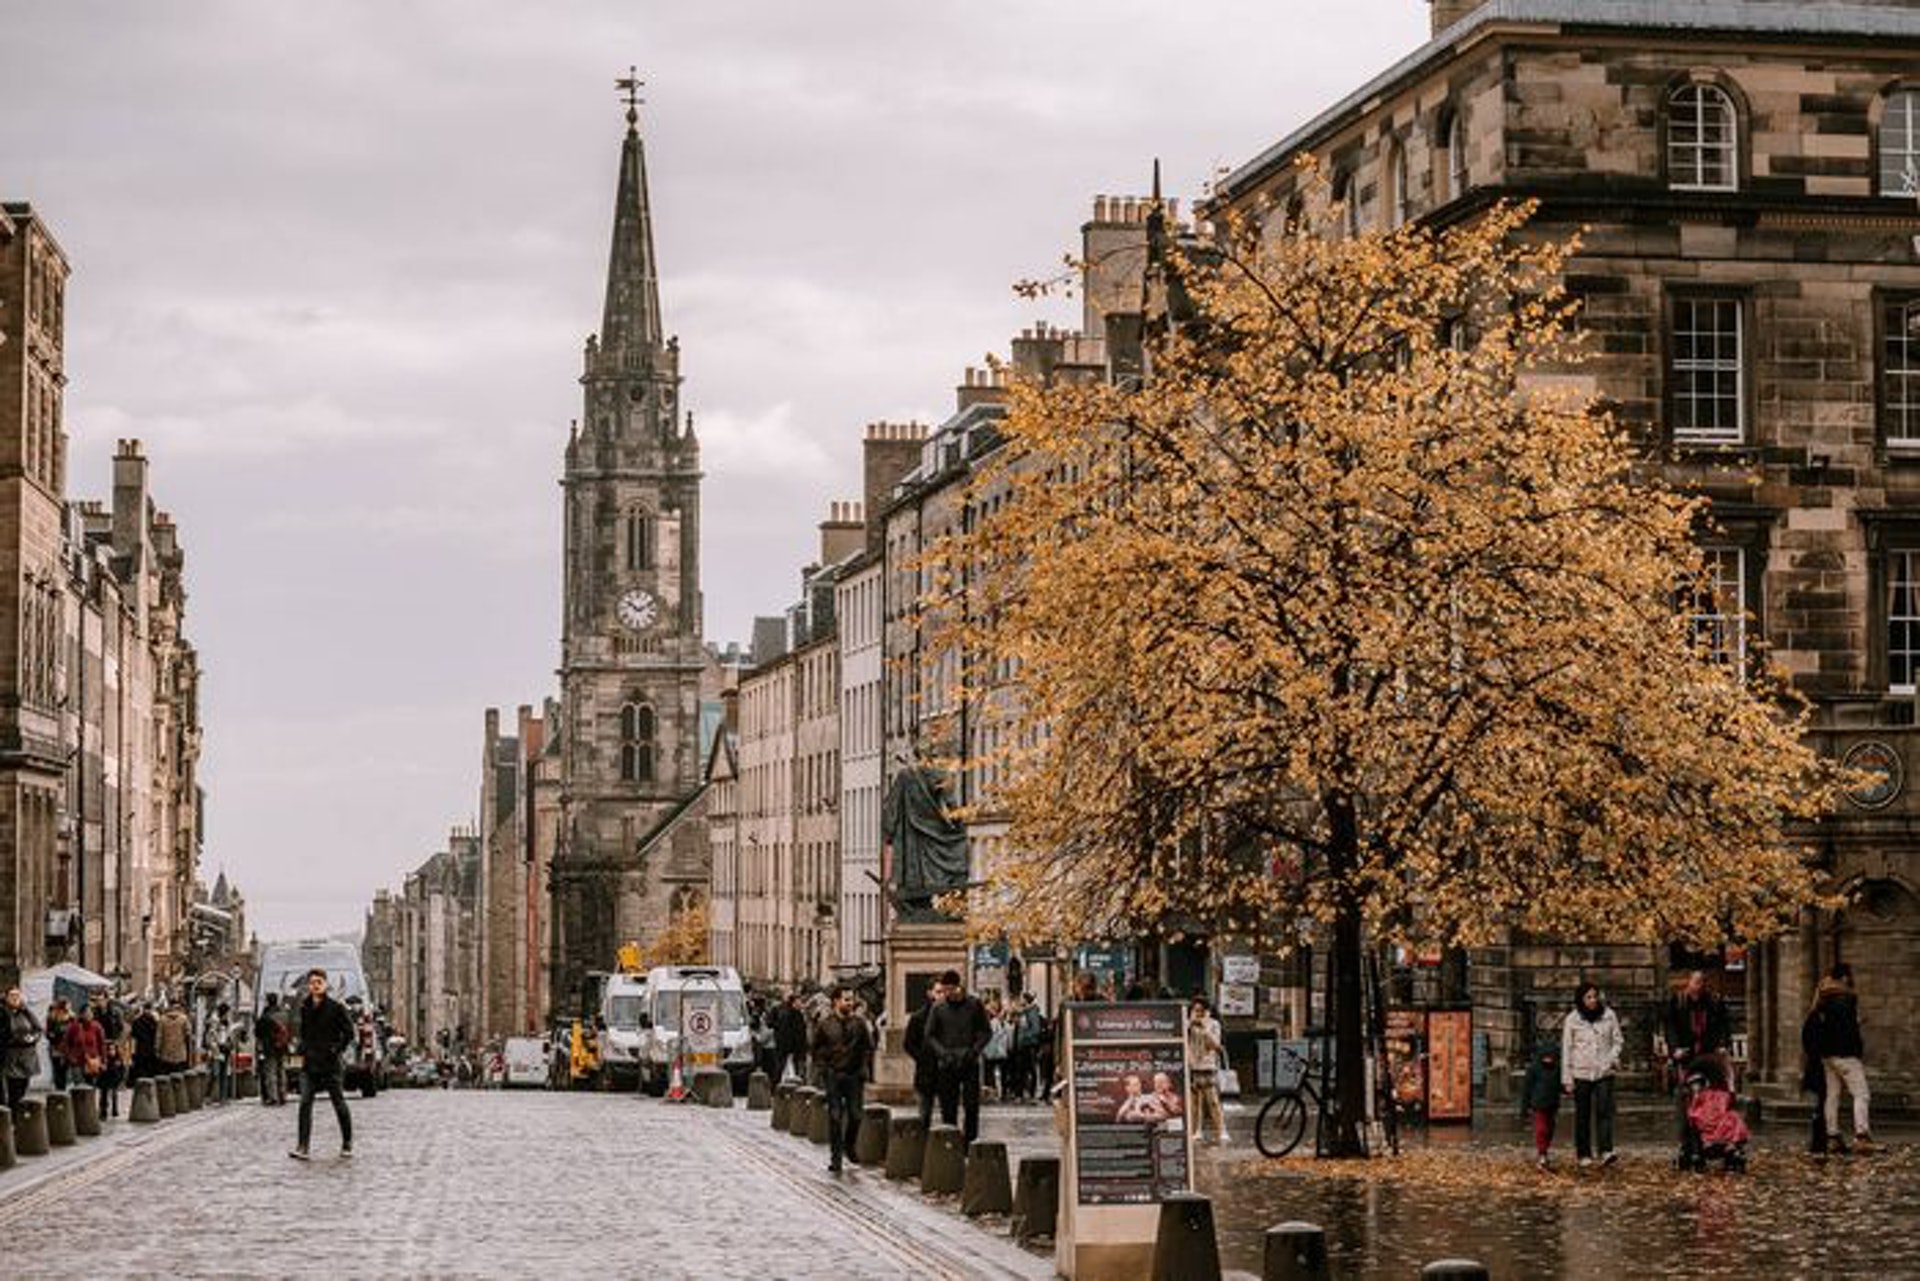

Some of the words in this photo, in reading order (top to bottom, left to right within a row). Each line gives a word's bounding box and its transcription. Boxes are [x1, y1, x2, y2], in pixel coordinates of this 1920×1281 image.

[1096, 1020, 1133, 1030] Literary
[1135, 1020, 1152, 1029] Pub
[1152, 1020, 1175, 1029] Tour
[1075, 1060, 1126, 1073] Literary
[1129, 1060, 1152, 1071] Pub
[1154, 1060, 1184, 1071] Tour
